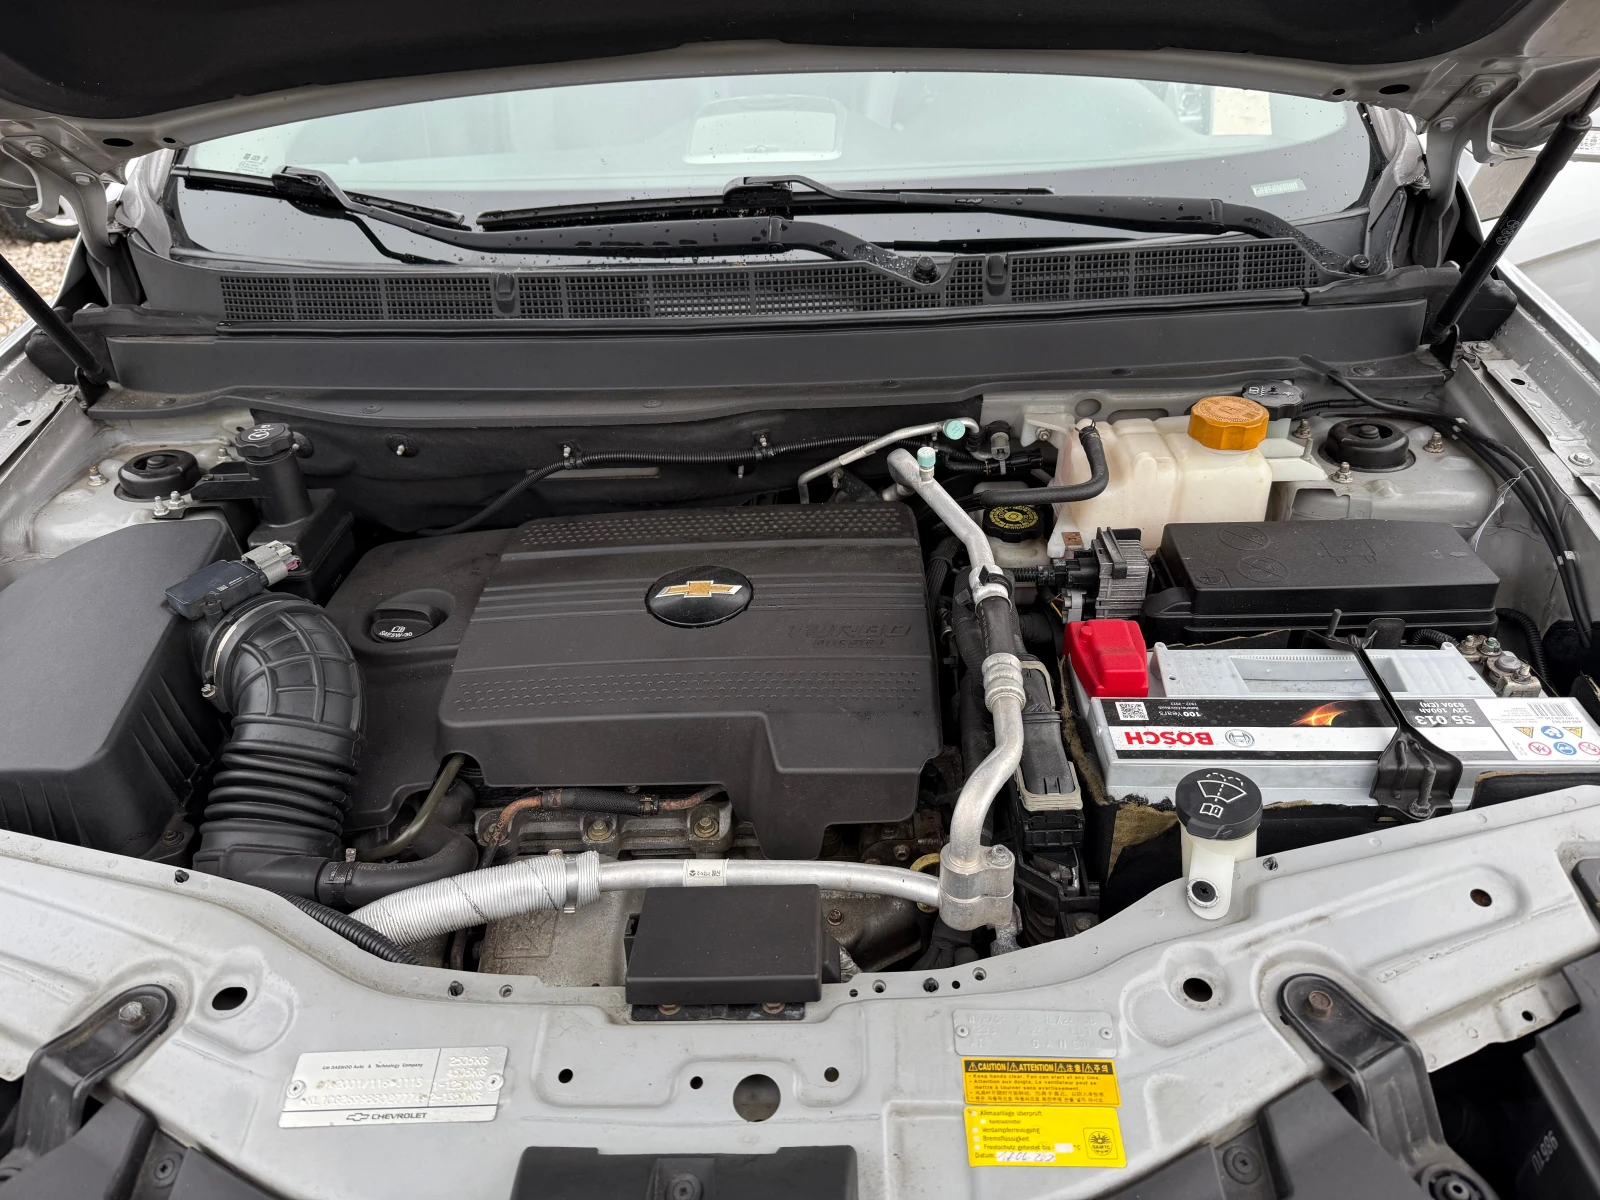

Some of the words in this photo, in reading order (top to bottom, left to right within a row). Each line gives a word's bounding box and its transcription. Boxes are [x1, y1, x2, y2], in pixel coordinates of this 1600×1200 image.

[1414, 715, 1448, 725] 013
[1451, 715, 1476, 725] S5
[1124, 731, 1214, 745] BOSCH
[978, 1062, 1006, 1071] CAUTION
[1019, 1063, 1054, 1072] ATTENTION
[371, 1112, 428, 1120] CHEVROLET
[982, 1127, 1040, 1135] Verdampferreinigung
